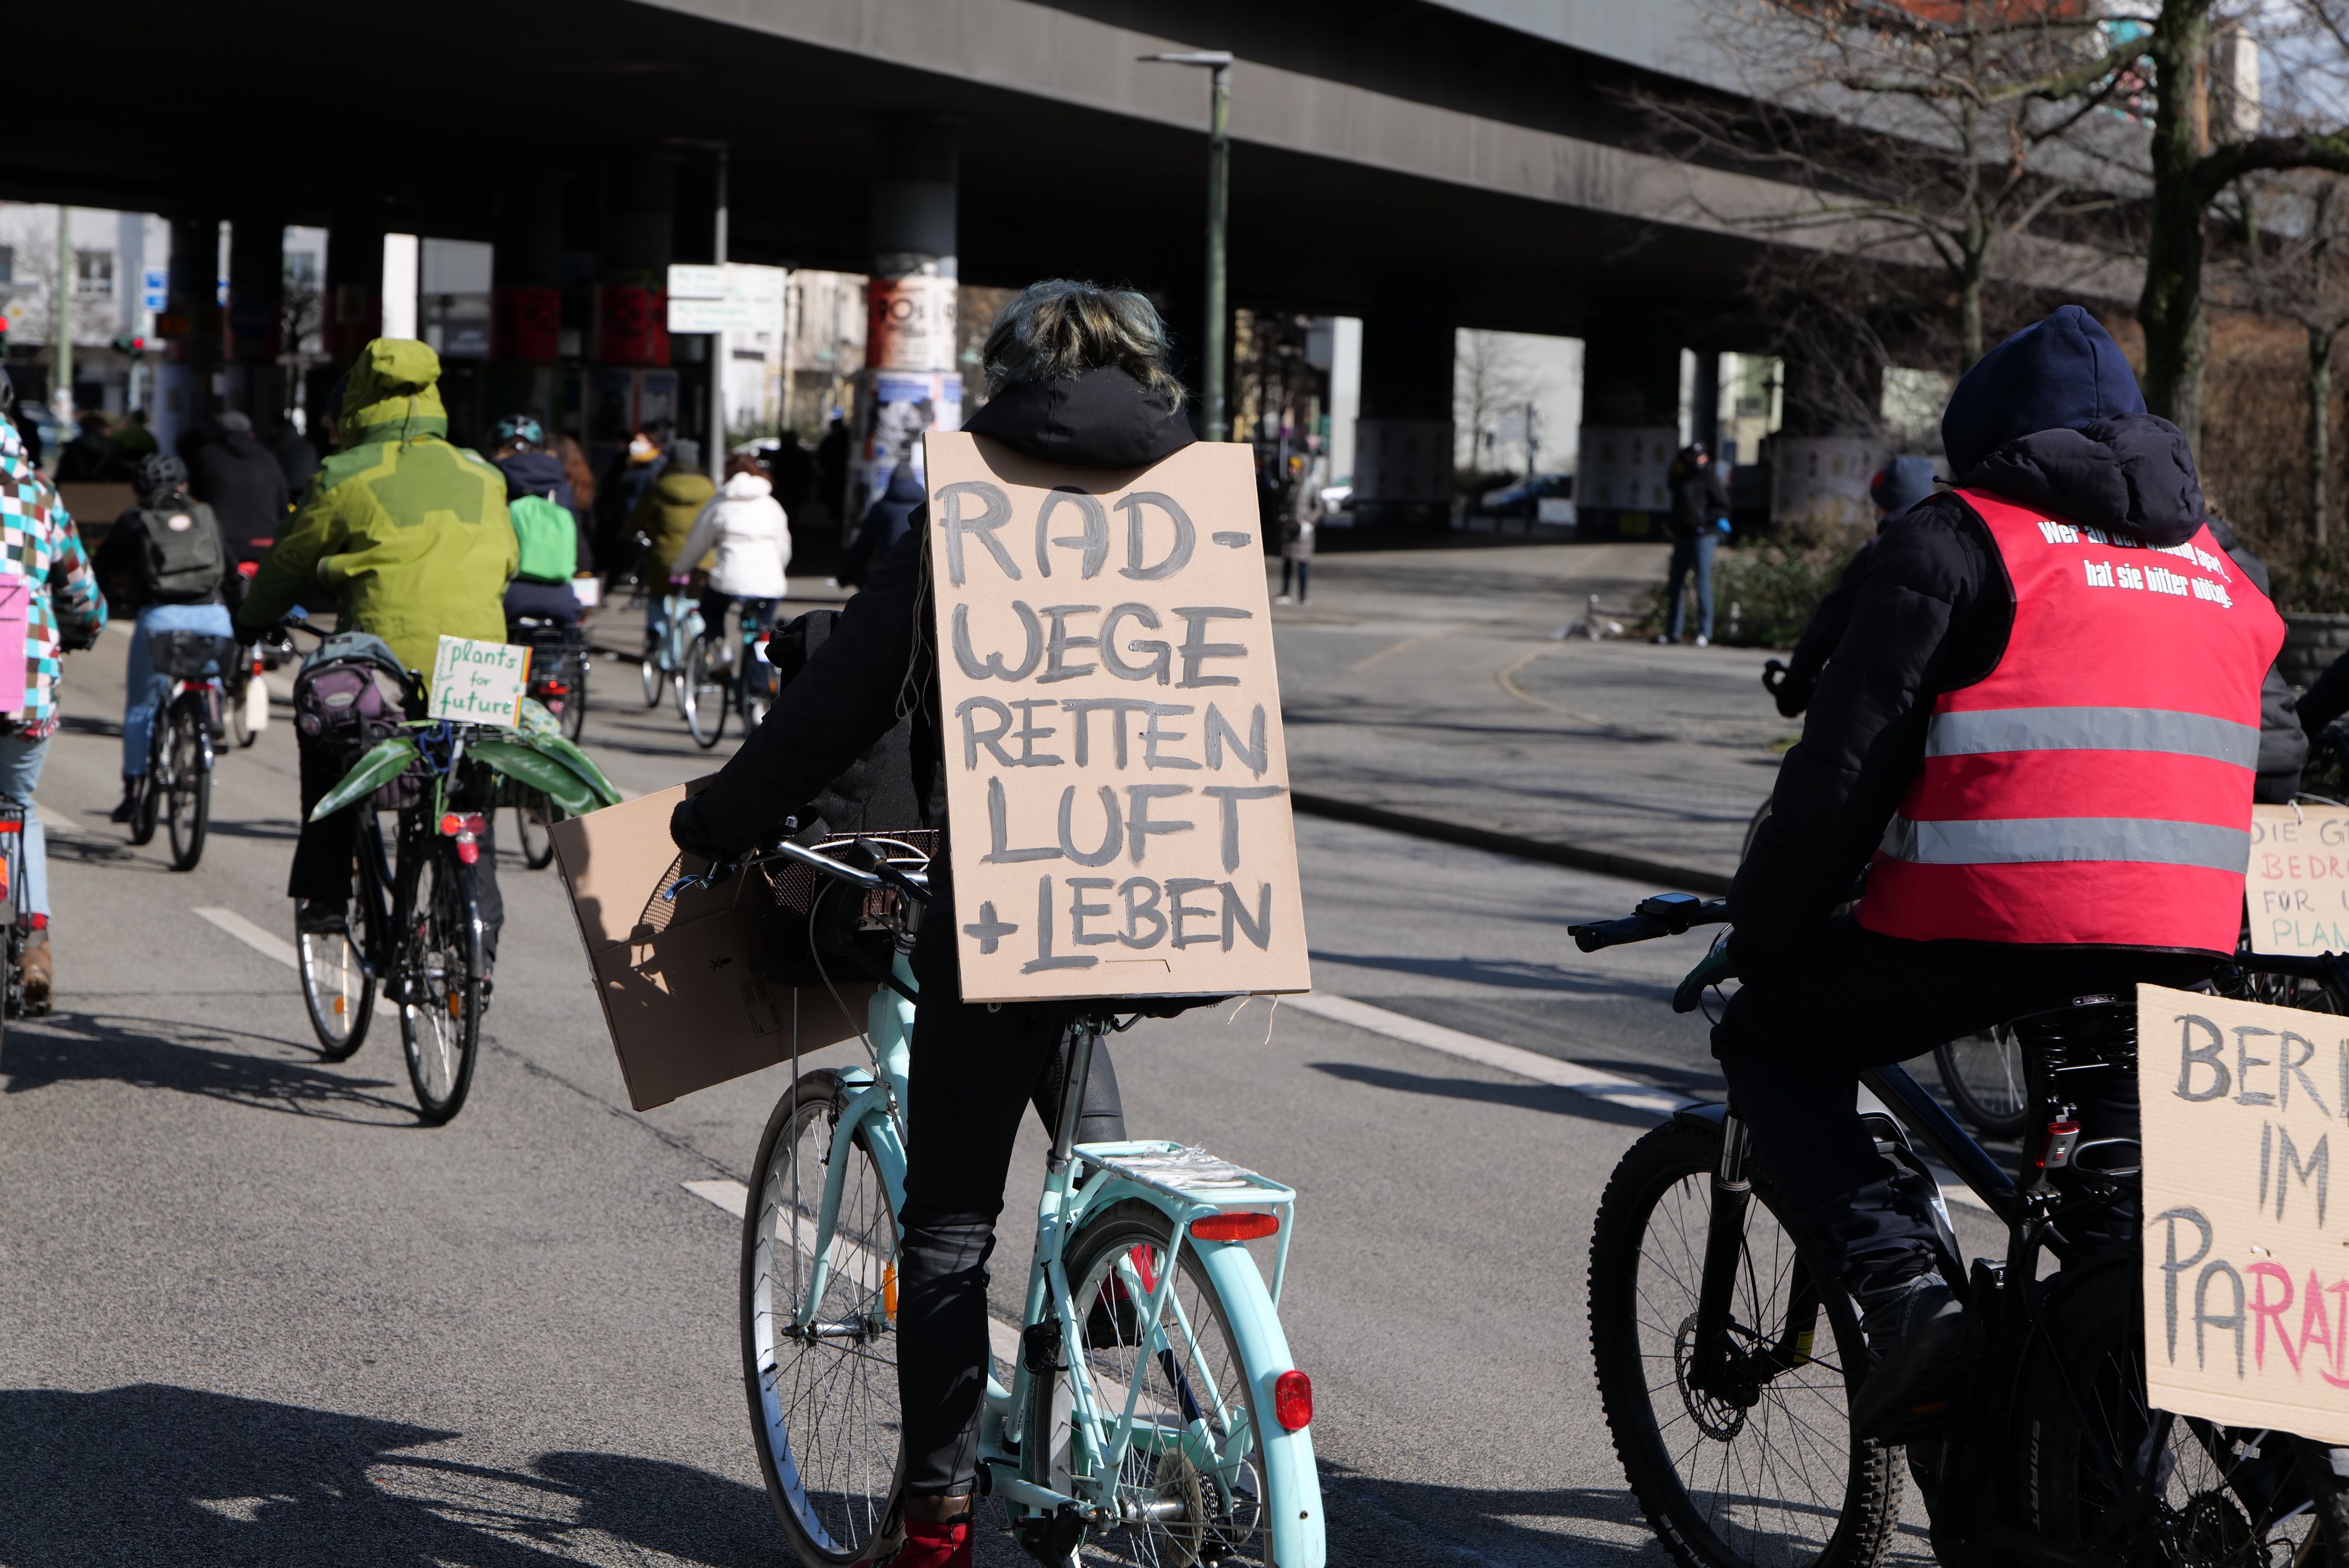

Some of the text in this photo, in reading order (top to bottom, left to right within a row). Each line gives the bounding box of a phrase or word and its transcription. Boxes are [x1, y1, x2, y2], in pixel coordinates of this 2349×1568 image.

[934, 480, 1251, 587] RAD-
[2036, 521, 2080, 544] Wer
[2083, 559, 2115, 587] hat
[2116, 563, 2144, 591] sie
[2144, 565, 2189, 596] bitter
[450, 640, 517, 671] plants
[950, 600, 1253, 687] WEGE
[470, 670, 491, 687] for
[440, 686, 512, 716] future
[955, 696, 1267, 780] RETTEN
[979, 776, 1288, 875] LUFT
[2250, 821, 2297, 845] DIE
[2261, 853, 2349, 881] BEDR
[2263, 889, 2315, 914] FÜR
[1018, 873, 1271, 974] LEBEN
[2259, 1120, 2329, 1230] IM
